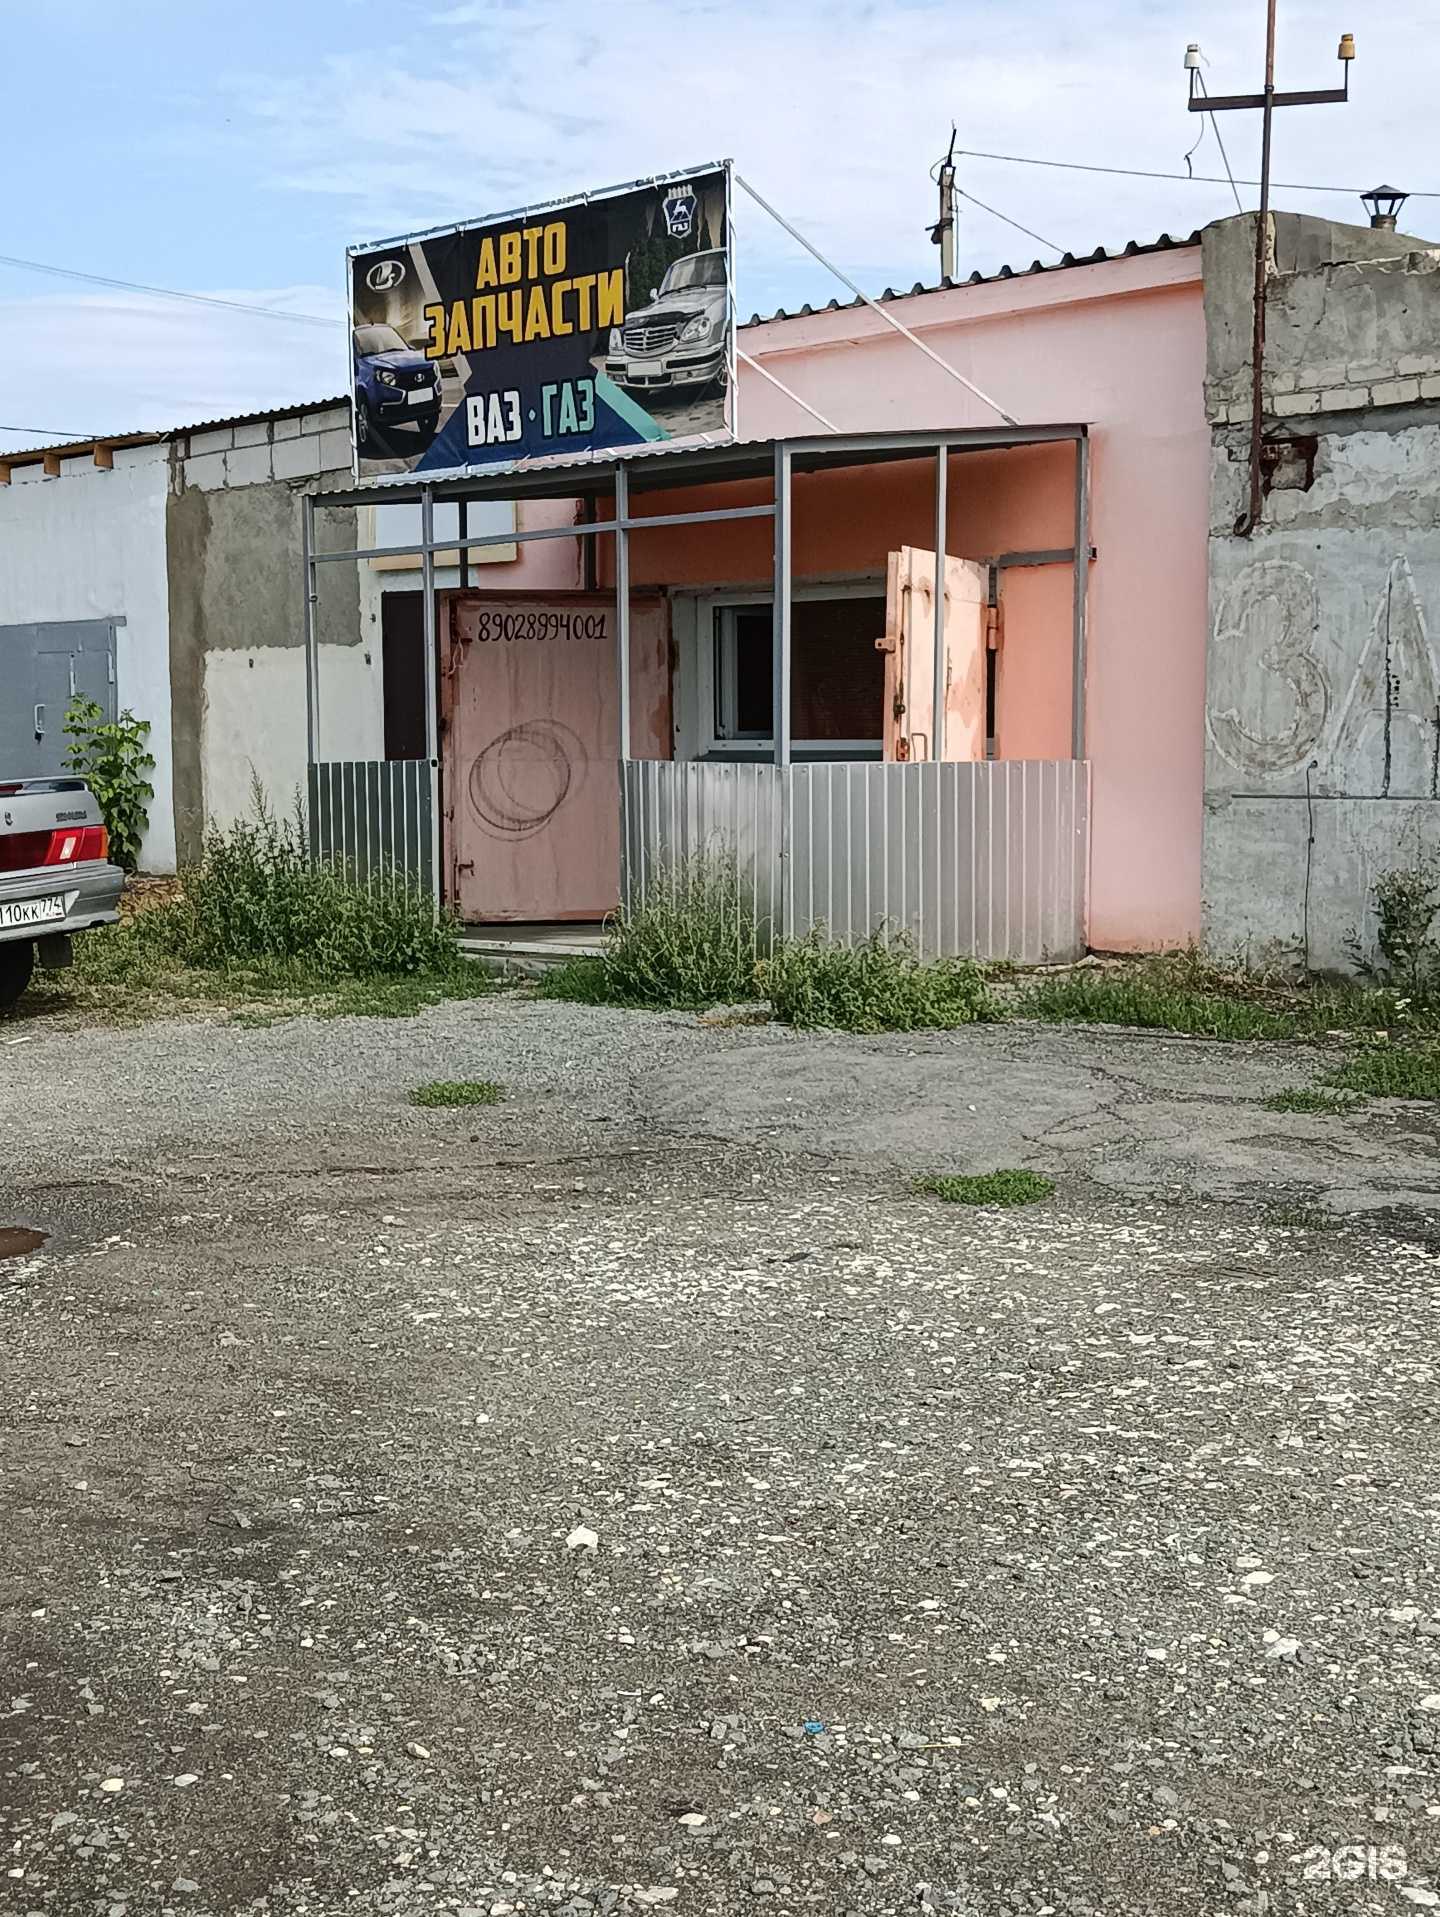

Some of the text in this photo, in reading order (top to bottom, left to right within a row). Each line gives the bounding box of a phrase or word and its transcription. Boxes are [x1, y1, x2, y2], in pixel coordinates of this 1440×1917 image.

[475, 222, 567, 290] АВТО
[425, 269, 624, 358] ЗАПЧАСТИ
[467, 377, 596, 447] ВАЗ ГАЗ
[478, 612, 607, 642] 89028994001
